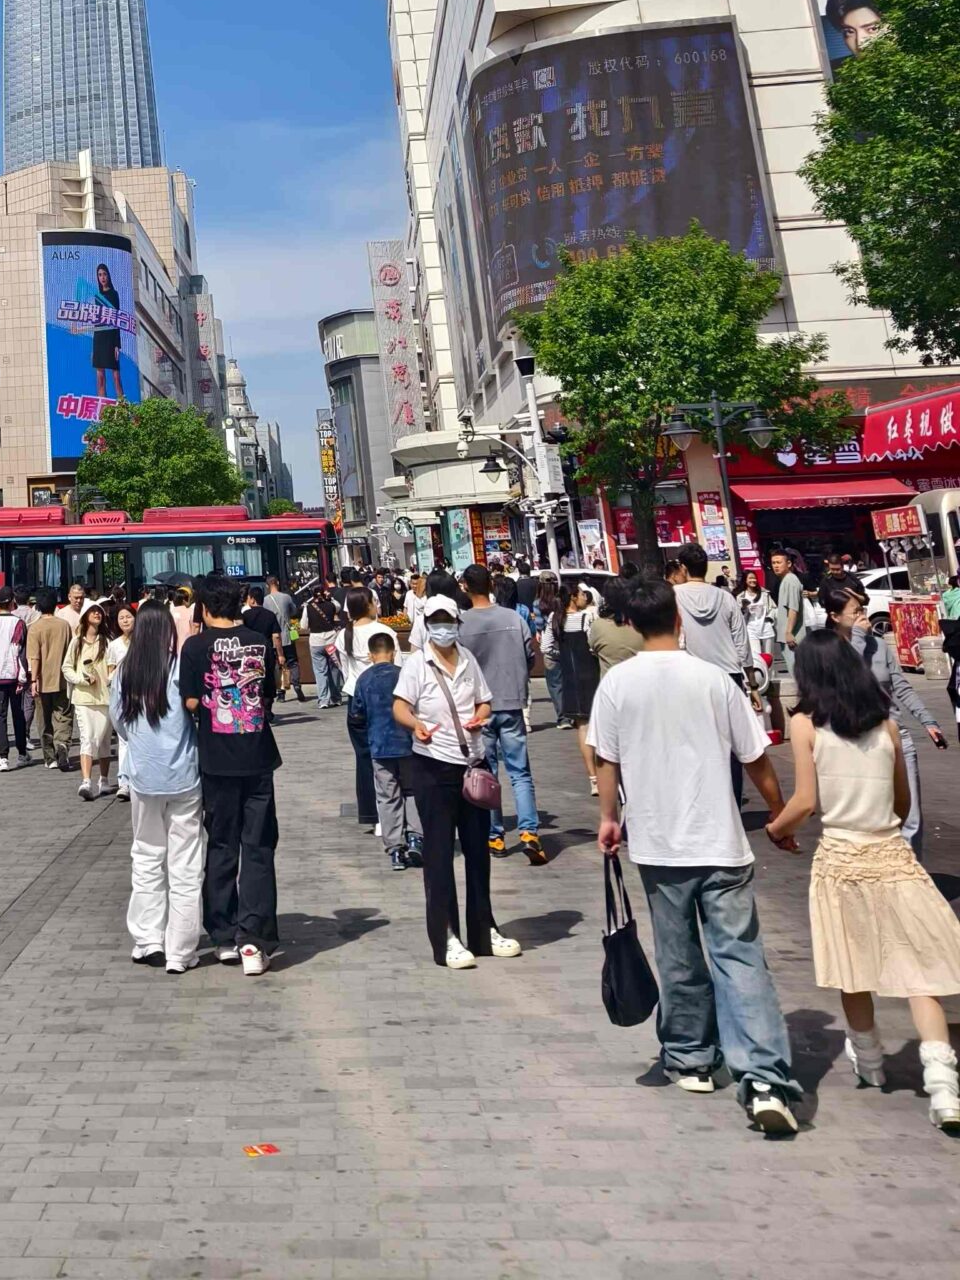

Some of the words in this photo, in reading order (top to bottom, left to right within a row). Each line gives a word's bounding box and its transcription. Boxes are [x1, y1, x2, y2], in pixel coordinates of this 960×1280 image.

[674, 48, 728, 64] 600168
[51, 251, 80, 261] ALIAS
[320, 430, 332, 438] TOP
[324, 477, 337, 486] TOP
[917, 477, 960, 492] 蜜雪冰
[324, 485, 337, 493] TOY
